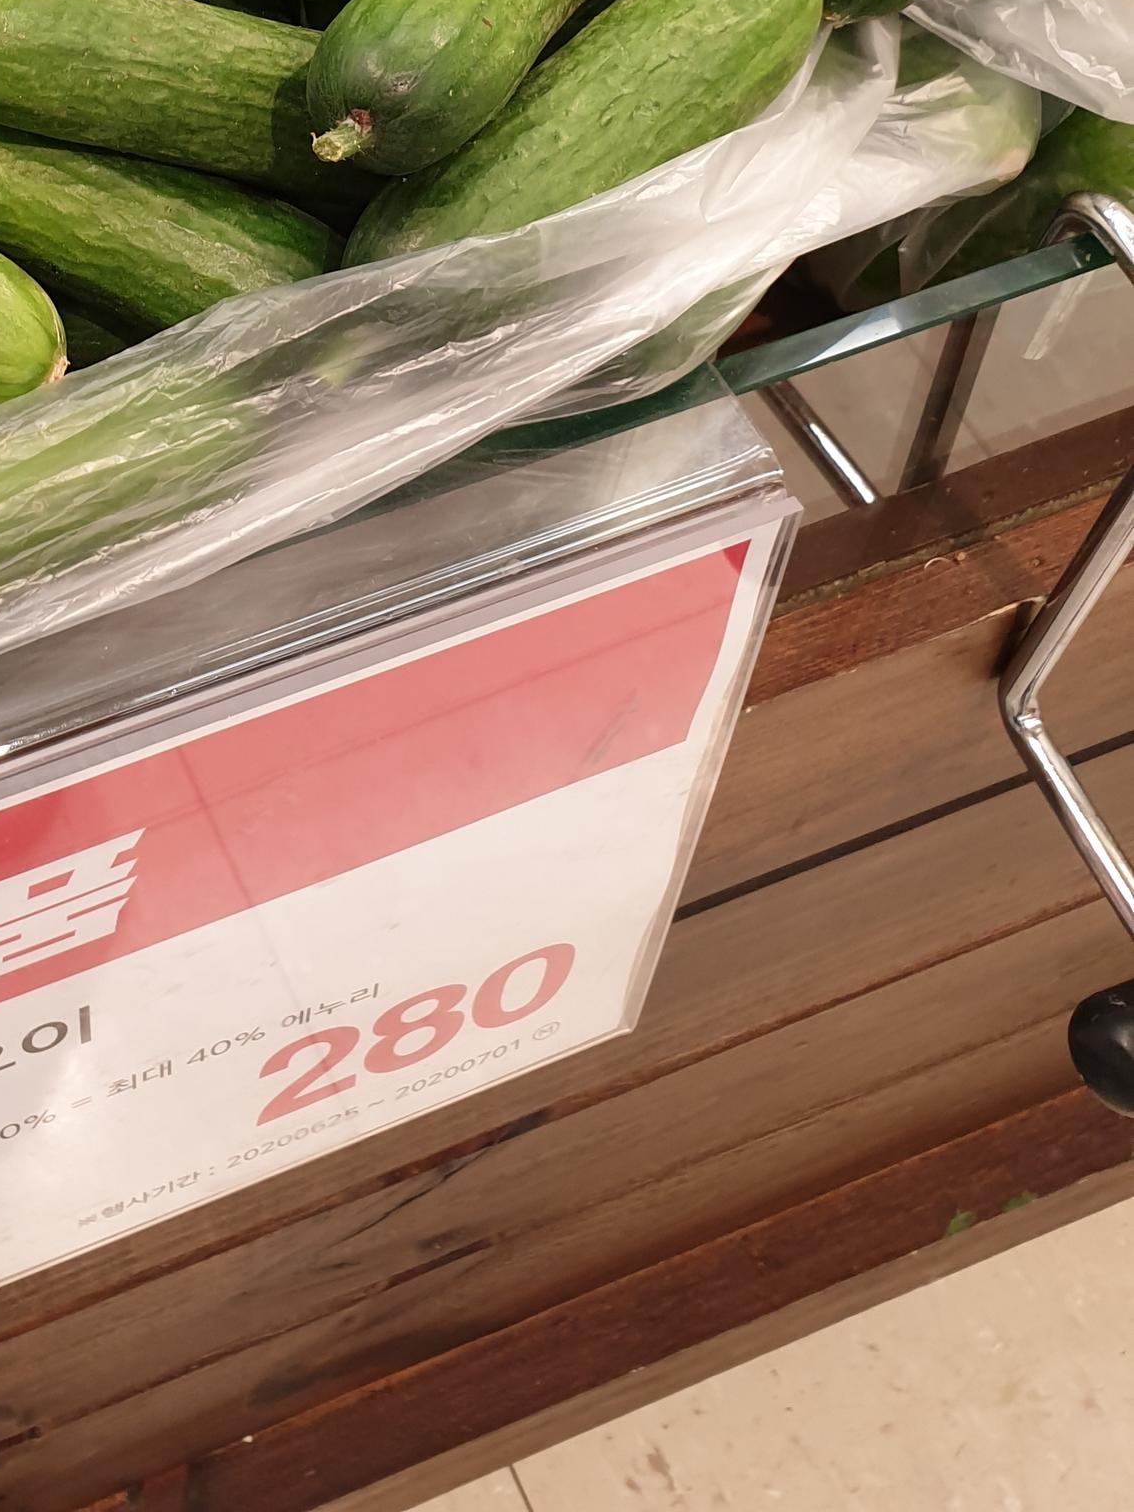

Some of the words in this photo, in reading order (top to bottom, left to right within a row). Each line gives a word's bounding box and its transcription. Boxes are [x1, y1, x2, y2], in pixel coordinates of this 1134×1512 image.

[106, 1059, 172, 1097] 최대
[186, 1026, 265, 1065] 40%
[281, 982, 379, 1028] 에누리
[256, 943, 576, 1126] 280
[227, 1107, 359, 1169] 20200625
[395, 1039, 520, 1100] 20200701
